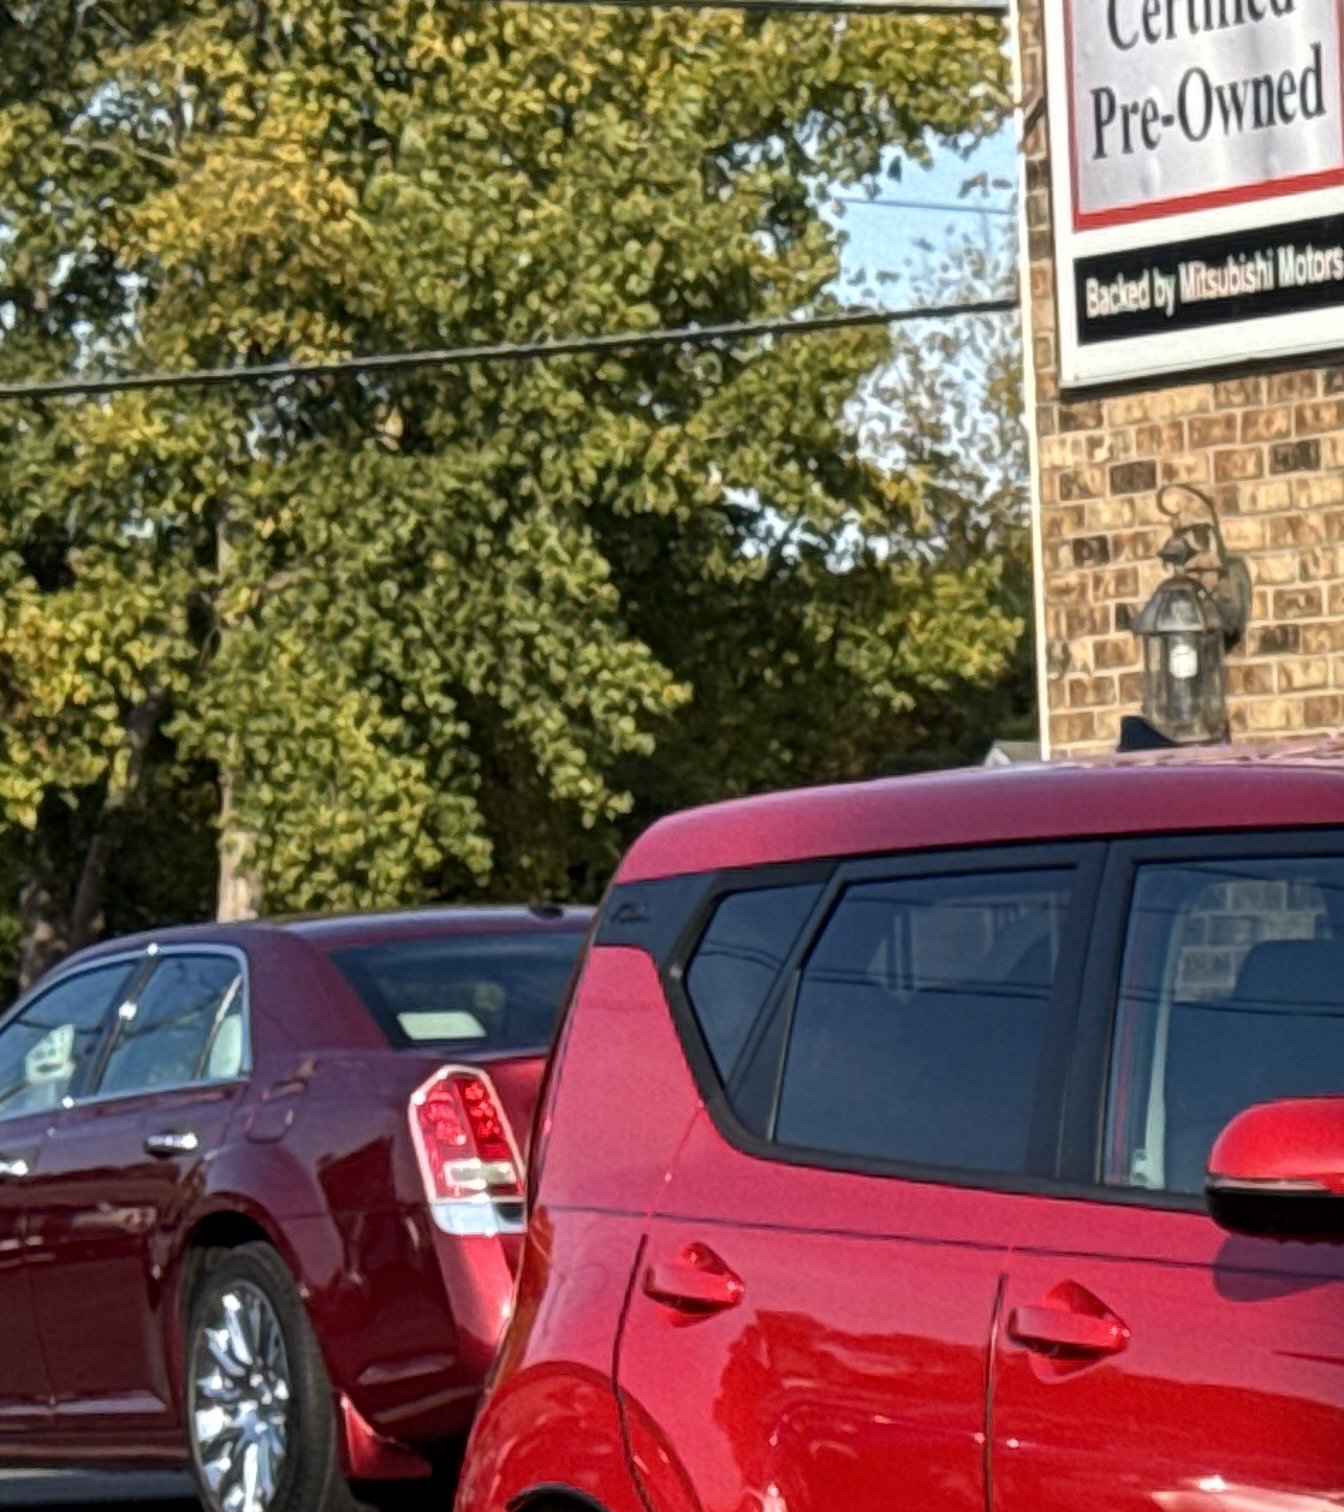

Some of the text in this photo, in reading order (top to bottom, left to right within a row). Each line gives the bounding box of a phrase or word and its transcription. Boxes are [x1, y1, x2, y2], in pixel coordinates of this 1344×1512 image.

[1090, 41, 1327, 160] Pre-Owned
[1085, 244, 1344, 318] Backed by Mitsubishi Motors
